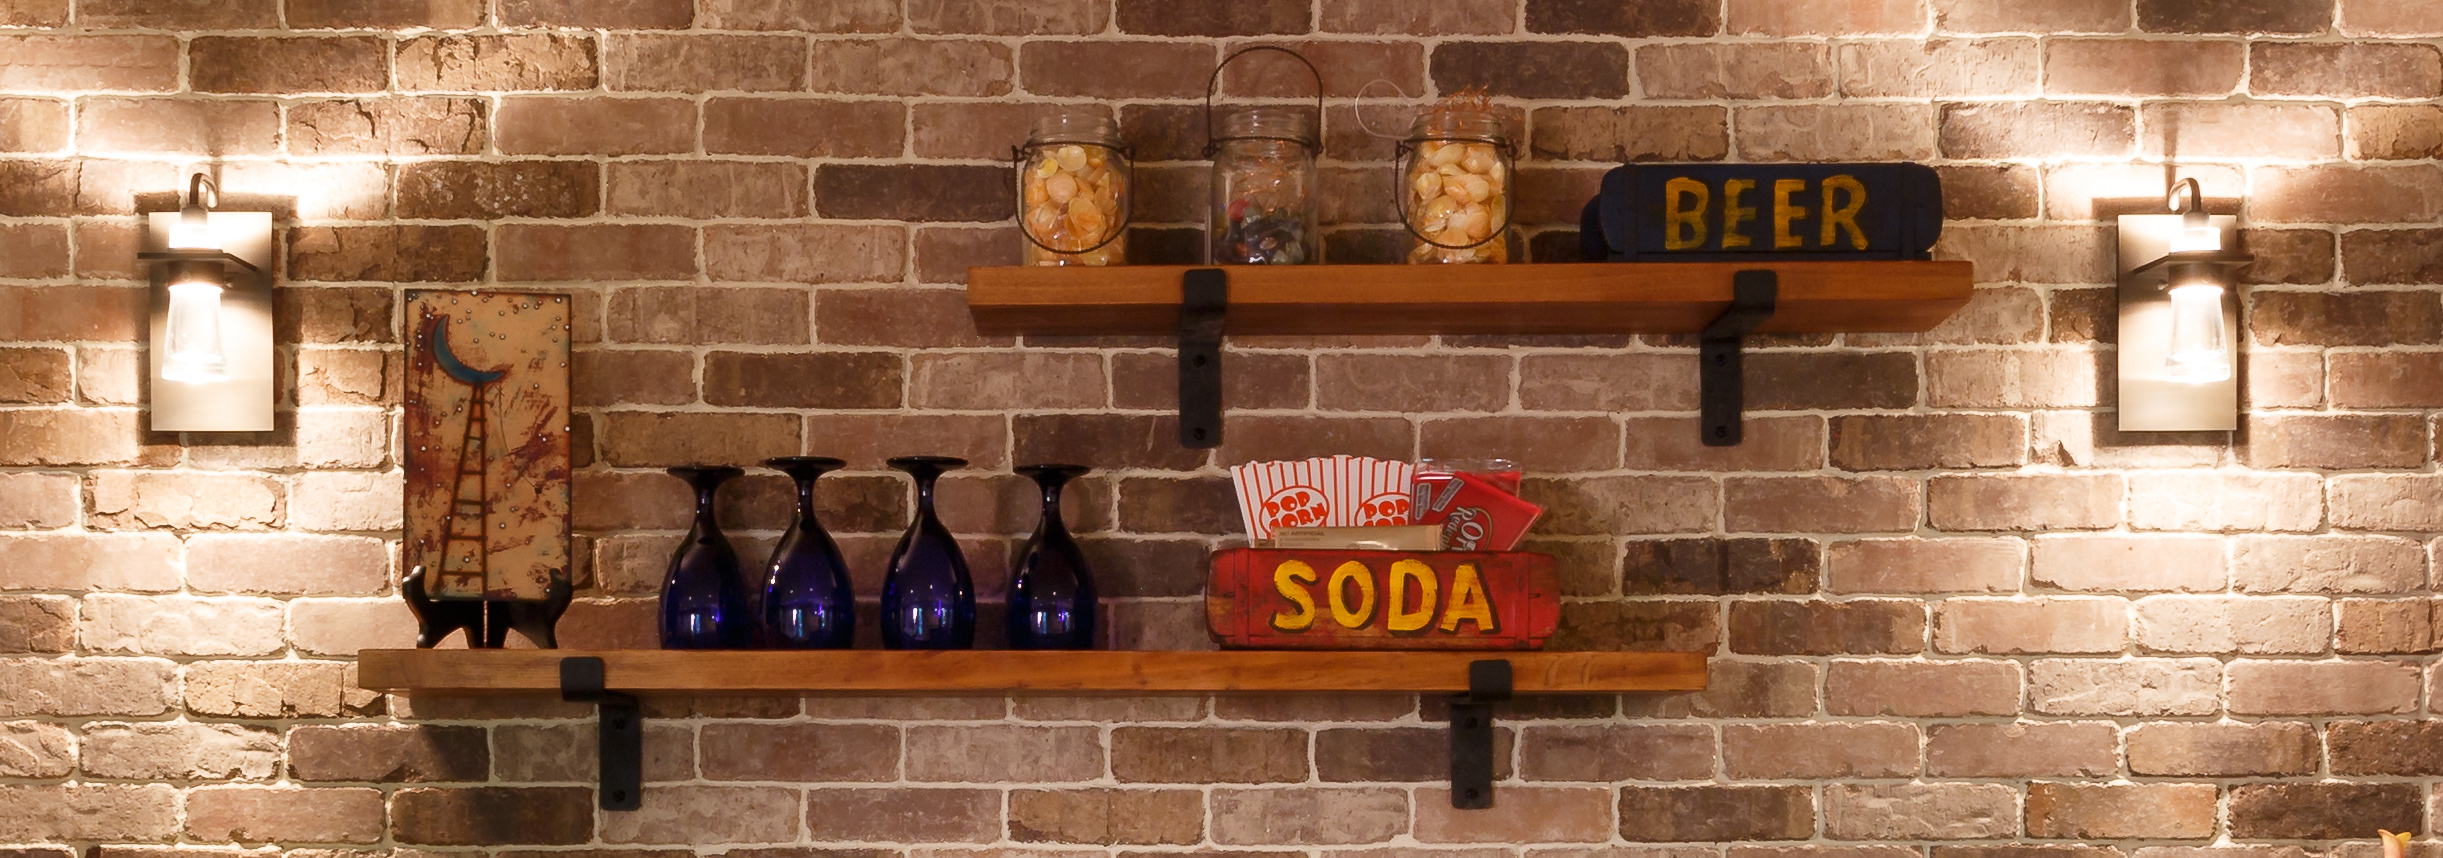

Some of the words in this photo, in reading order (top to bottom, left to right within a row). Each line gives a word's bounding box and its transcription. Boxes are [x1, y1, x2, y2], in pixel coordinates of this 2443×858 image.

[1665, 174, 1868, 251] BEER
[1264, 491, 1310, 518] POP
[1363, 499, 1409, 519] POP
[1272, 558, 1497, 634] SODA
